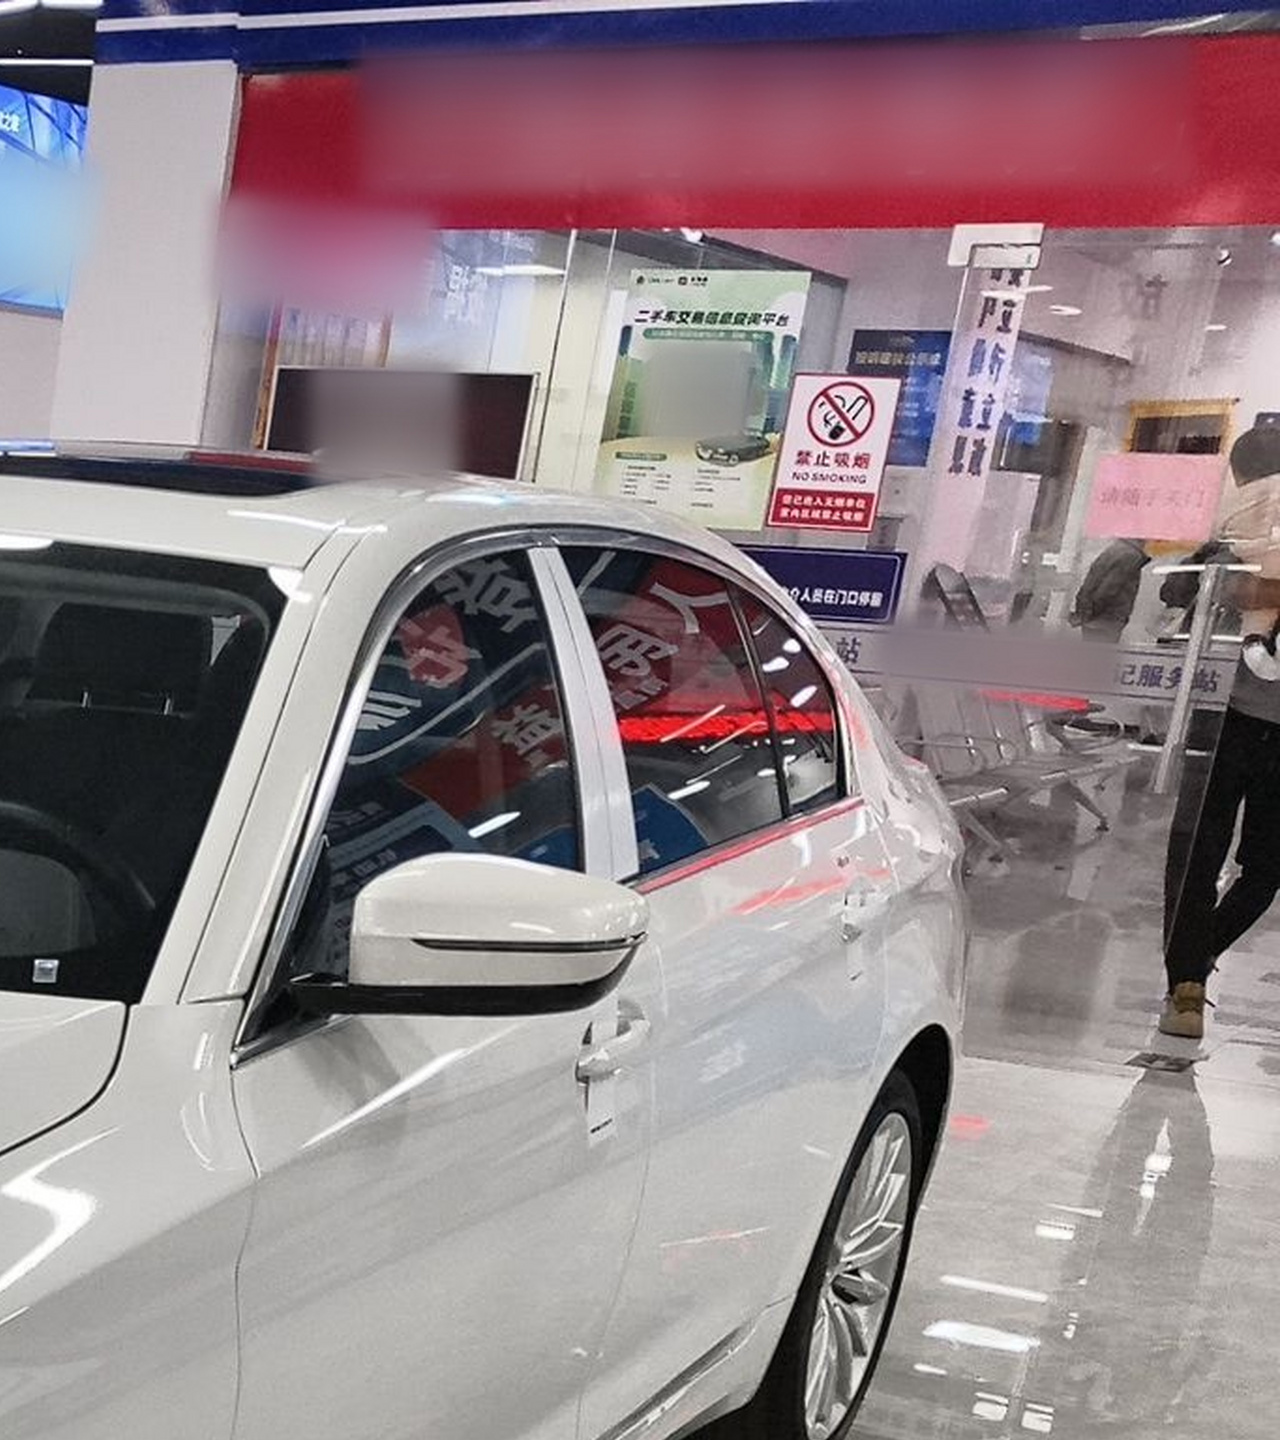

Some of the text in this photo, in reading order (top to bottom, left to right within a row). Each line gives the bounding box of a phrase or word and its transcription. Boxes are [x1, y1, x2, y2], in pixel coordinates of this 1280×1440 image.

[634, 310, 790, 327] 二手车交易信息查询平台
[795, 450, 871, 469] 禁止吸烟
[792, 471, 868, 484] NO SMOKING
[782, 585, 884, 608] 介人员在门口停留
